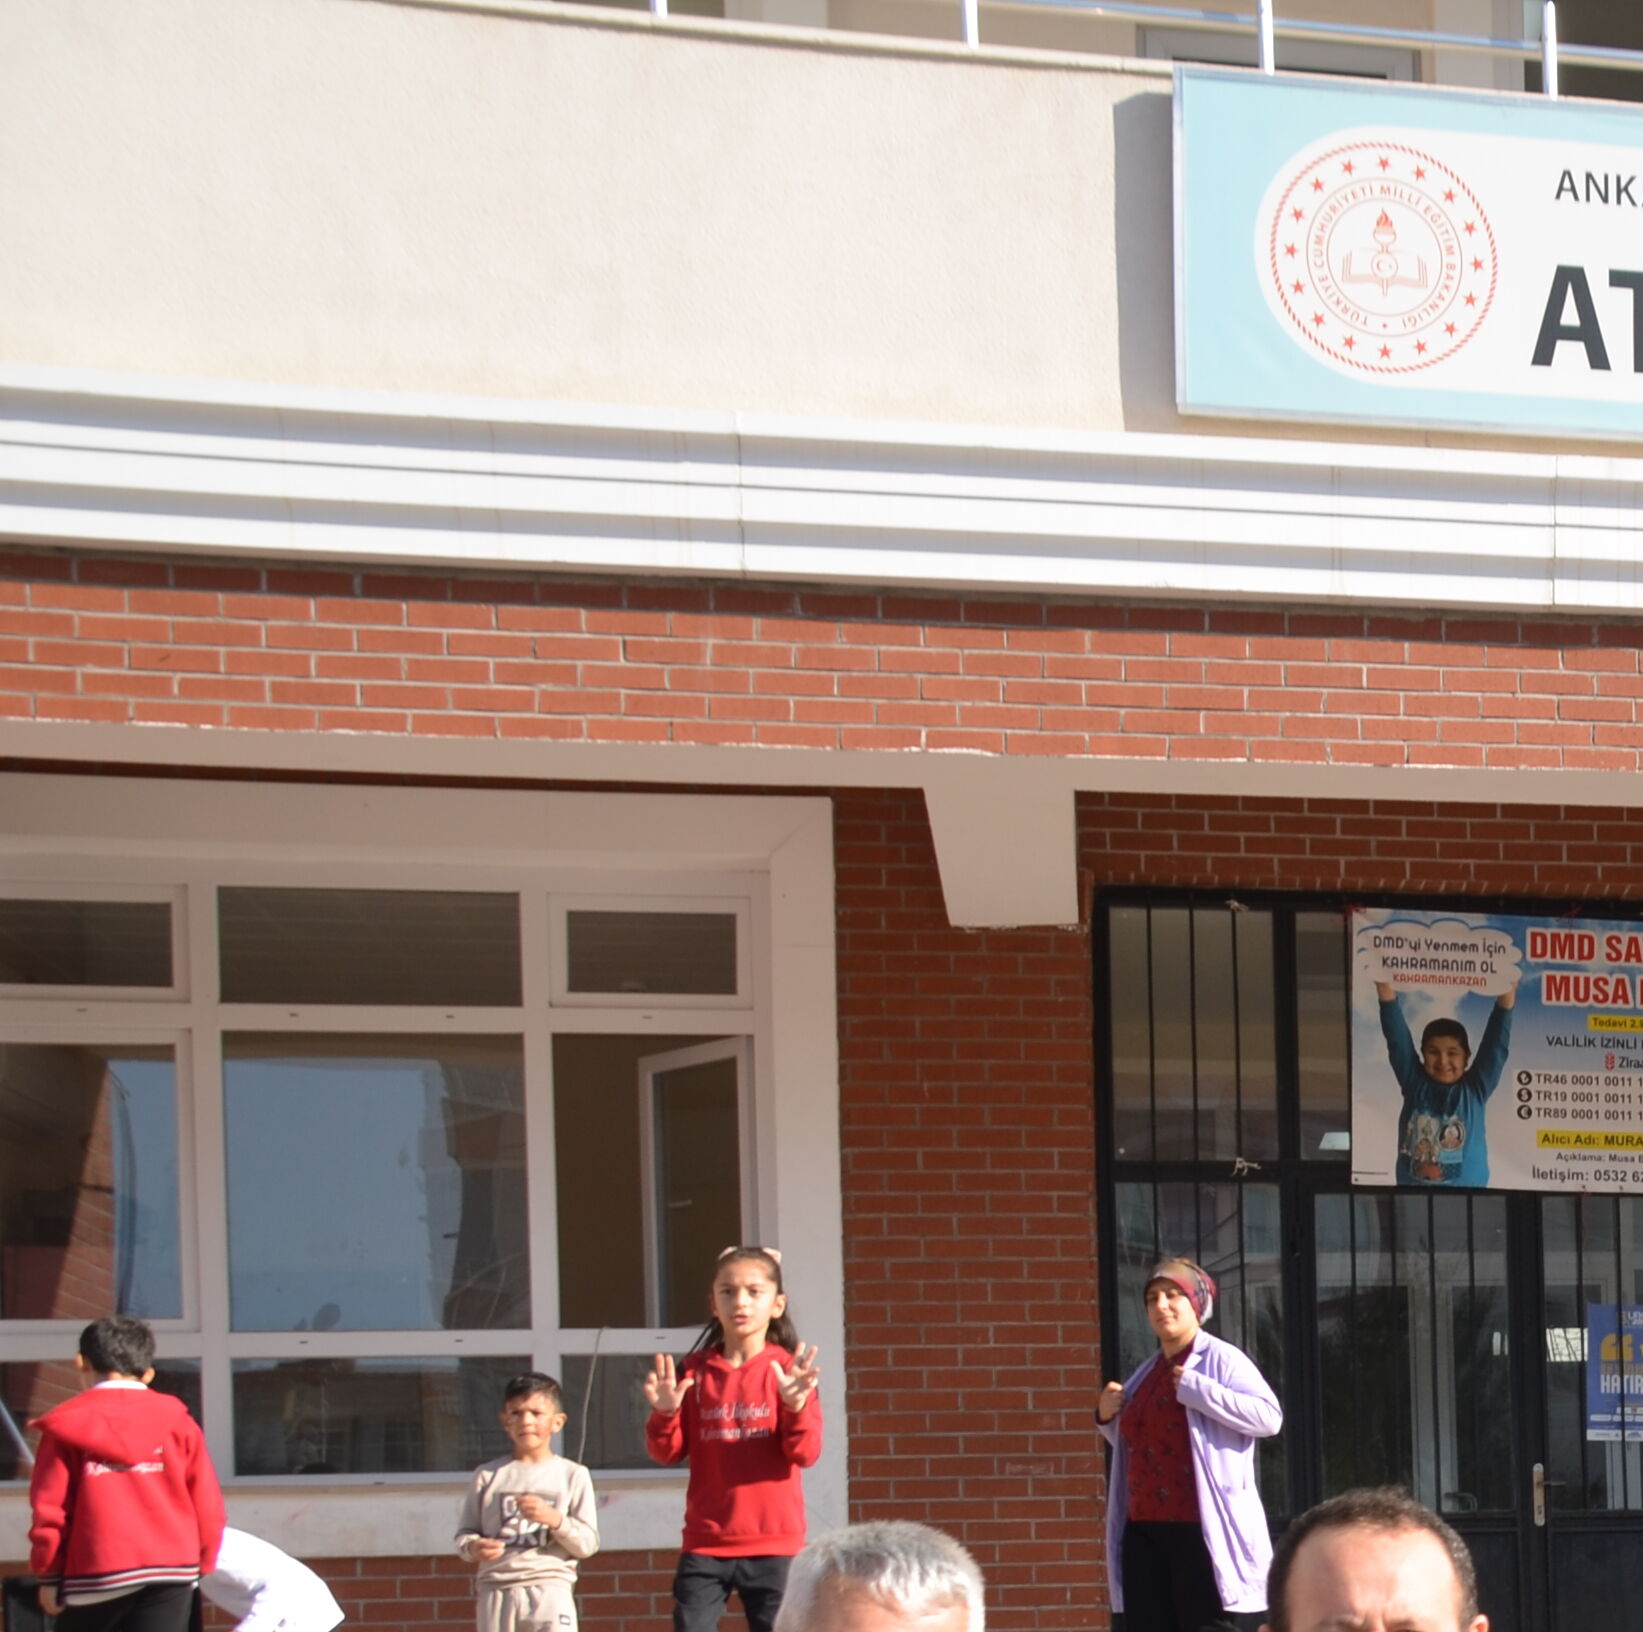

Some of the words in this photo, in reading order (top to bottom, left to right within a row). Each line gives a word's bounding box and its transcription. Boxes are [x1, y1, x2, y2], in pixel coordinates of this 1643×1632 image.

[1425, 938, 1479, 953] Yenmem
[1483, 937, 1507, 958] İçin
[1529, 930, 1595, 961] DMD
[1381, 956, 1476, 972] KAHRAMANIM
[1480, 961, 1497, 974] OL
[1392, 973, 1487, 987] KAHRAMANKAZAN
[1545, 974, 1631, 1006] MUSA
[1546, 1034, 1597, 1049] VALİLİK
[1600, 1035, 1638, 1050] İZİNLİ
[1593, 1169, 1628, 1183] 0532
